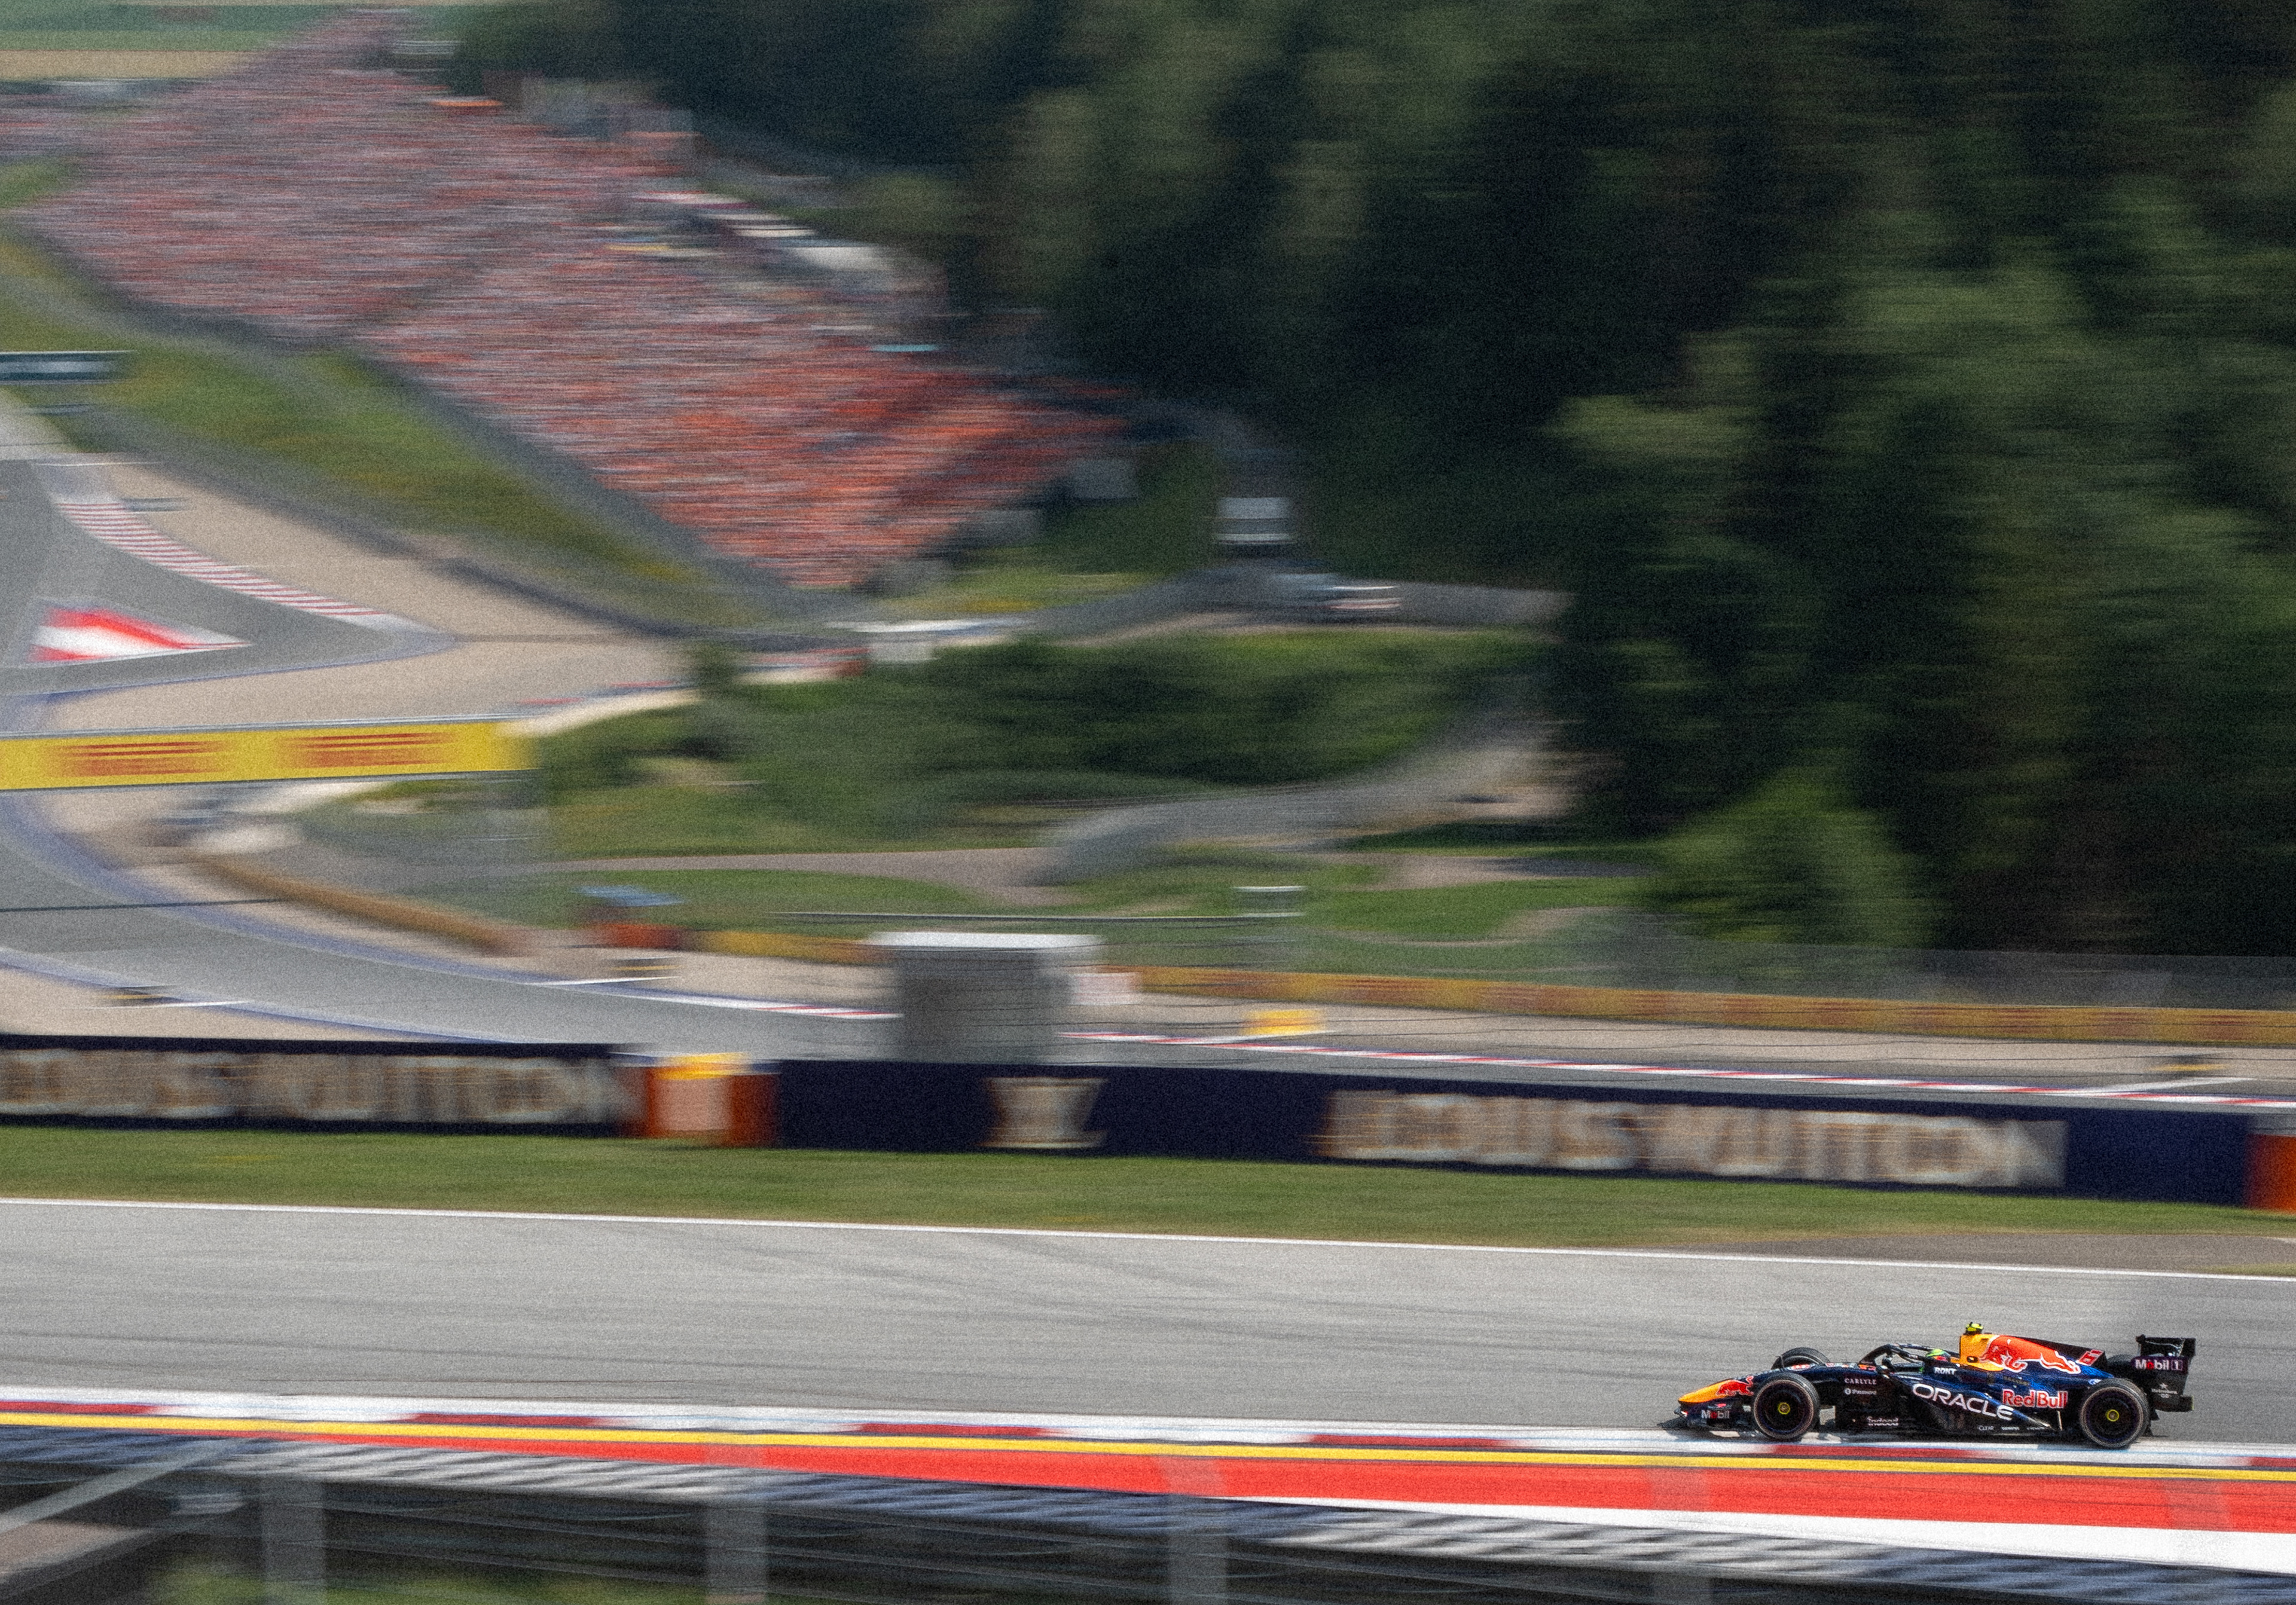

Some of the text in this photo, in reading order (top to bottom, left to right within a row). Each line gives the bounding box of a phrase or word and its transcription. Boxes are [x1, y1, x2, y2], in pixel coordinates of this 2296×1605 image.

[2135, 1359, 2169, 1370] Mobil
[1934, 1366, 1957, 1375] ROKT
[1913, 1383, 2014, 1421] ORACLE
[2002, 1388, 2068, 1408] Red Bull
[1701, 1409, 1730, 1419] Mobil
